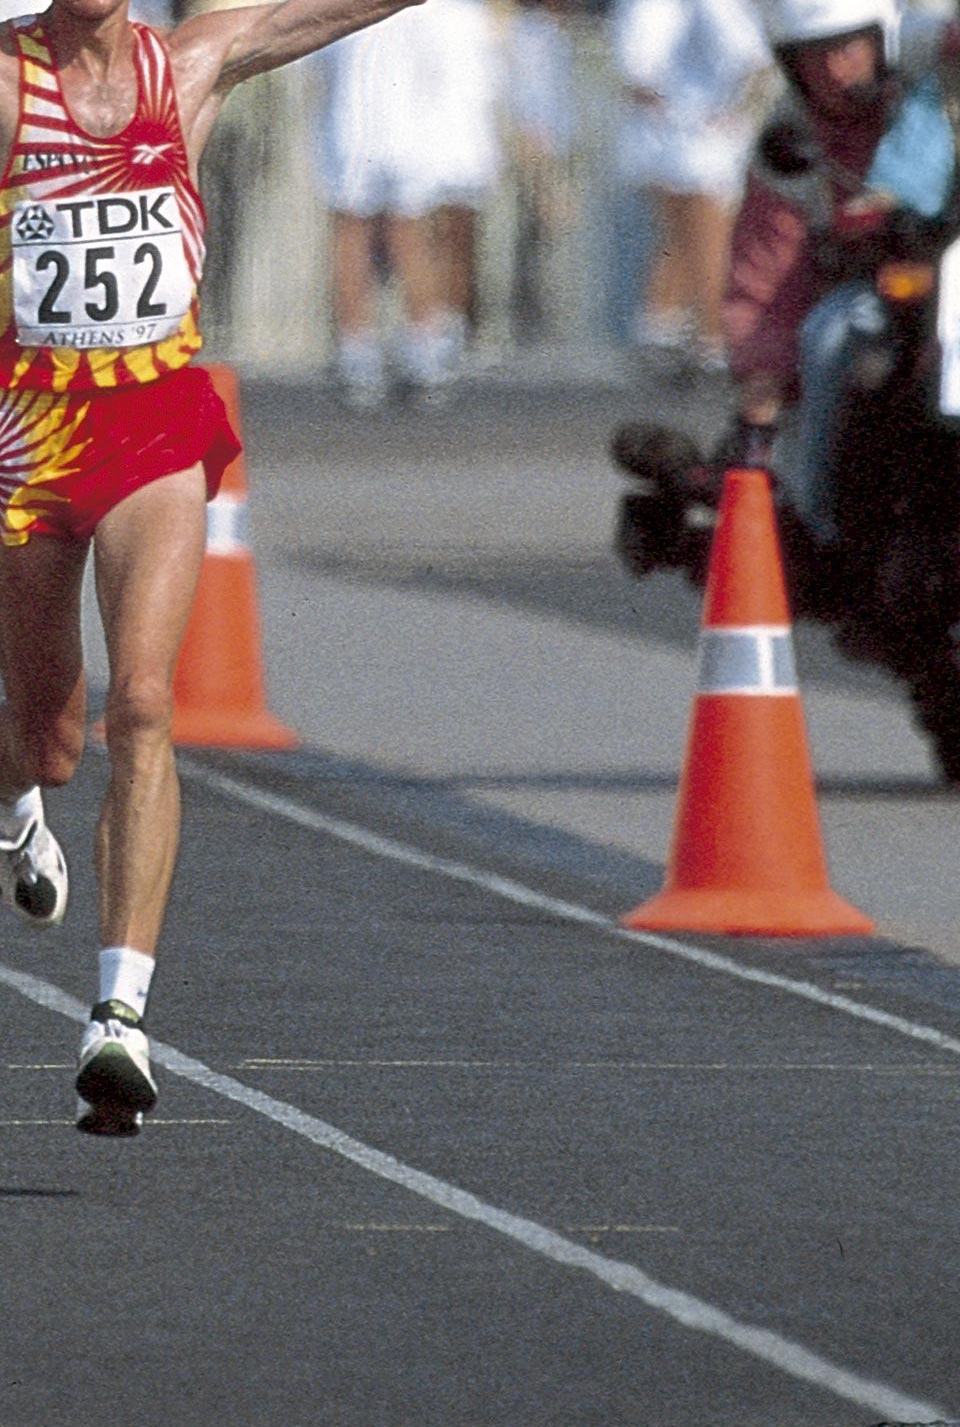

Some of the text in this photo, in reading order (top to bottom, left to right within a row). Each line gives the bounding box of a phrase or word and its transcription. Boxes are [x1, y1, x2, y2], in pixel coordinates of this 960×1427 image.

[56, 193, 174, 238] TDK
[36, 243, 167, 324] 252
[43, 330, 125, 346] ATHENS
